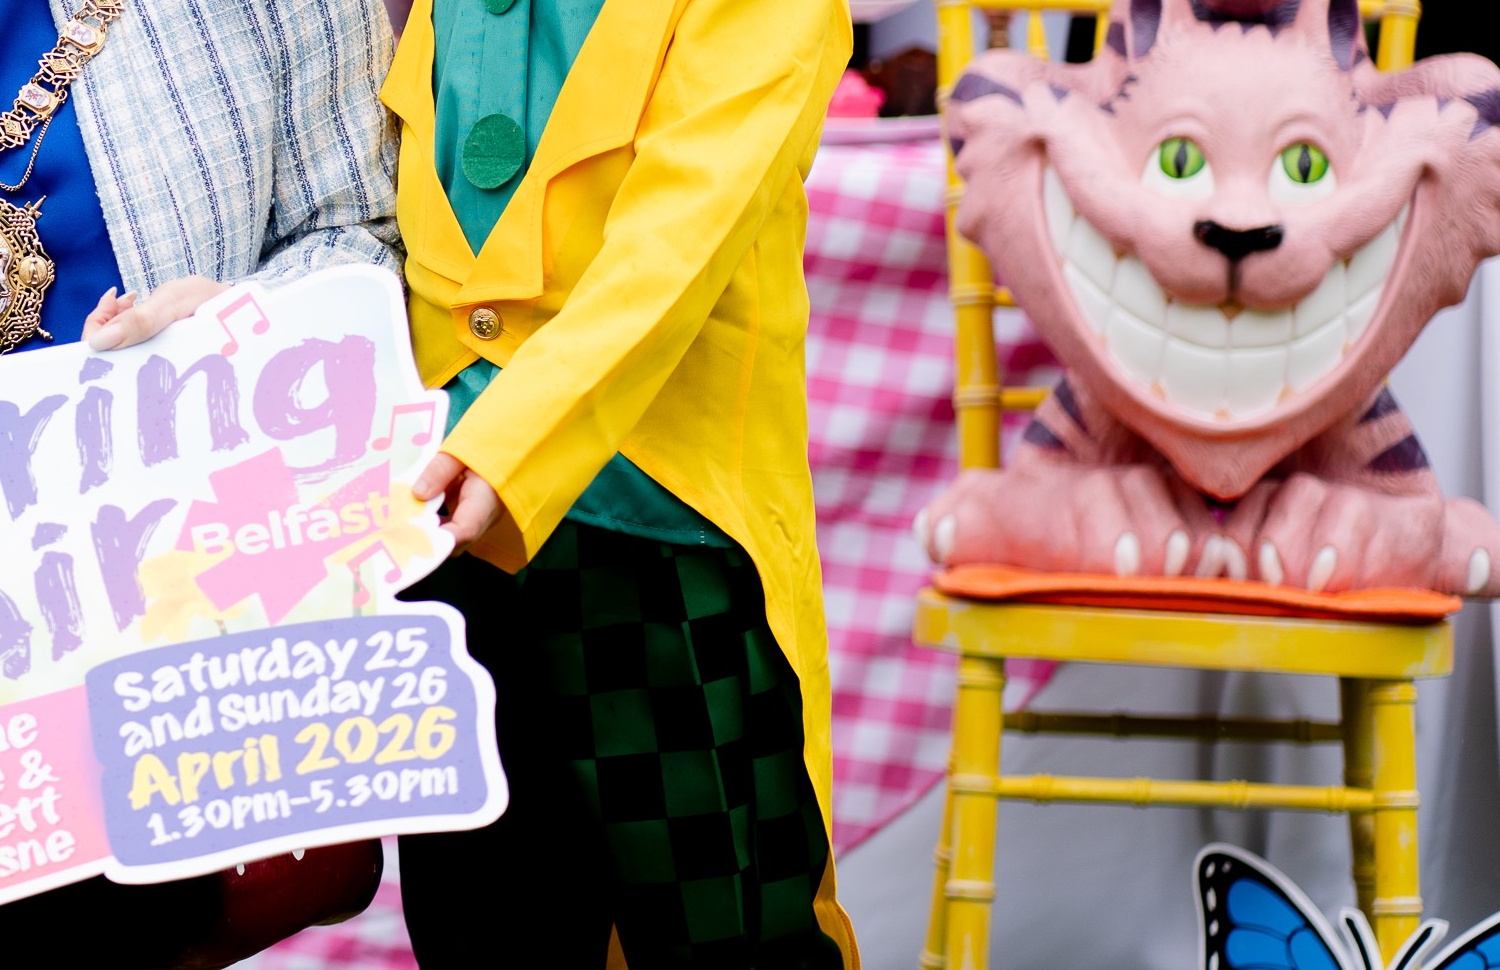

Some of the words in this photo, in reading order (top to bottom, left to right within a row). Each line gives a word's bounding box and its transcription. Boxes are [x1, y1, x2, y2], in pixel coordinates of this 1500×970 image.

[191, 490, 393, 559] Belfast
[113, 637, 359, 712] Saturday
[364, 627, 429, 672] 25
[119, 696, 215, 757] and
[390, 666, 448, 709] 26
[18, 749, 62, 790] &
[128, 733, 282, 810] April
[294, 705, 457, 775] 2026
